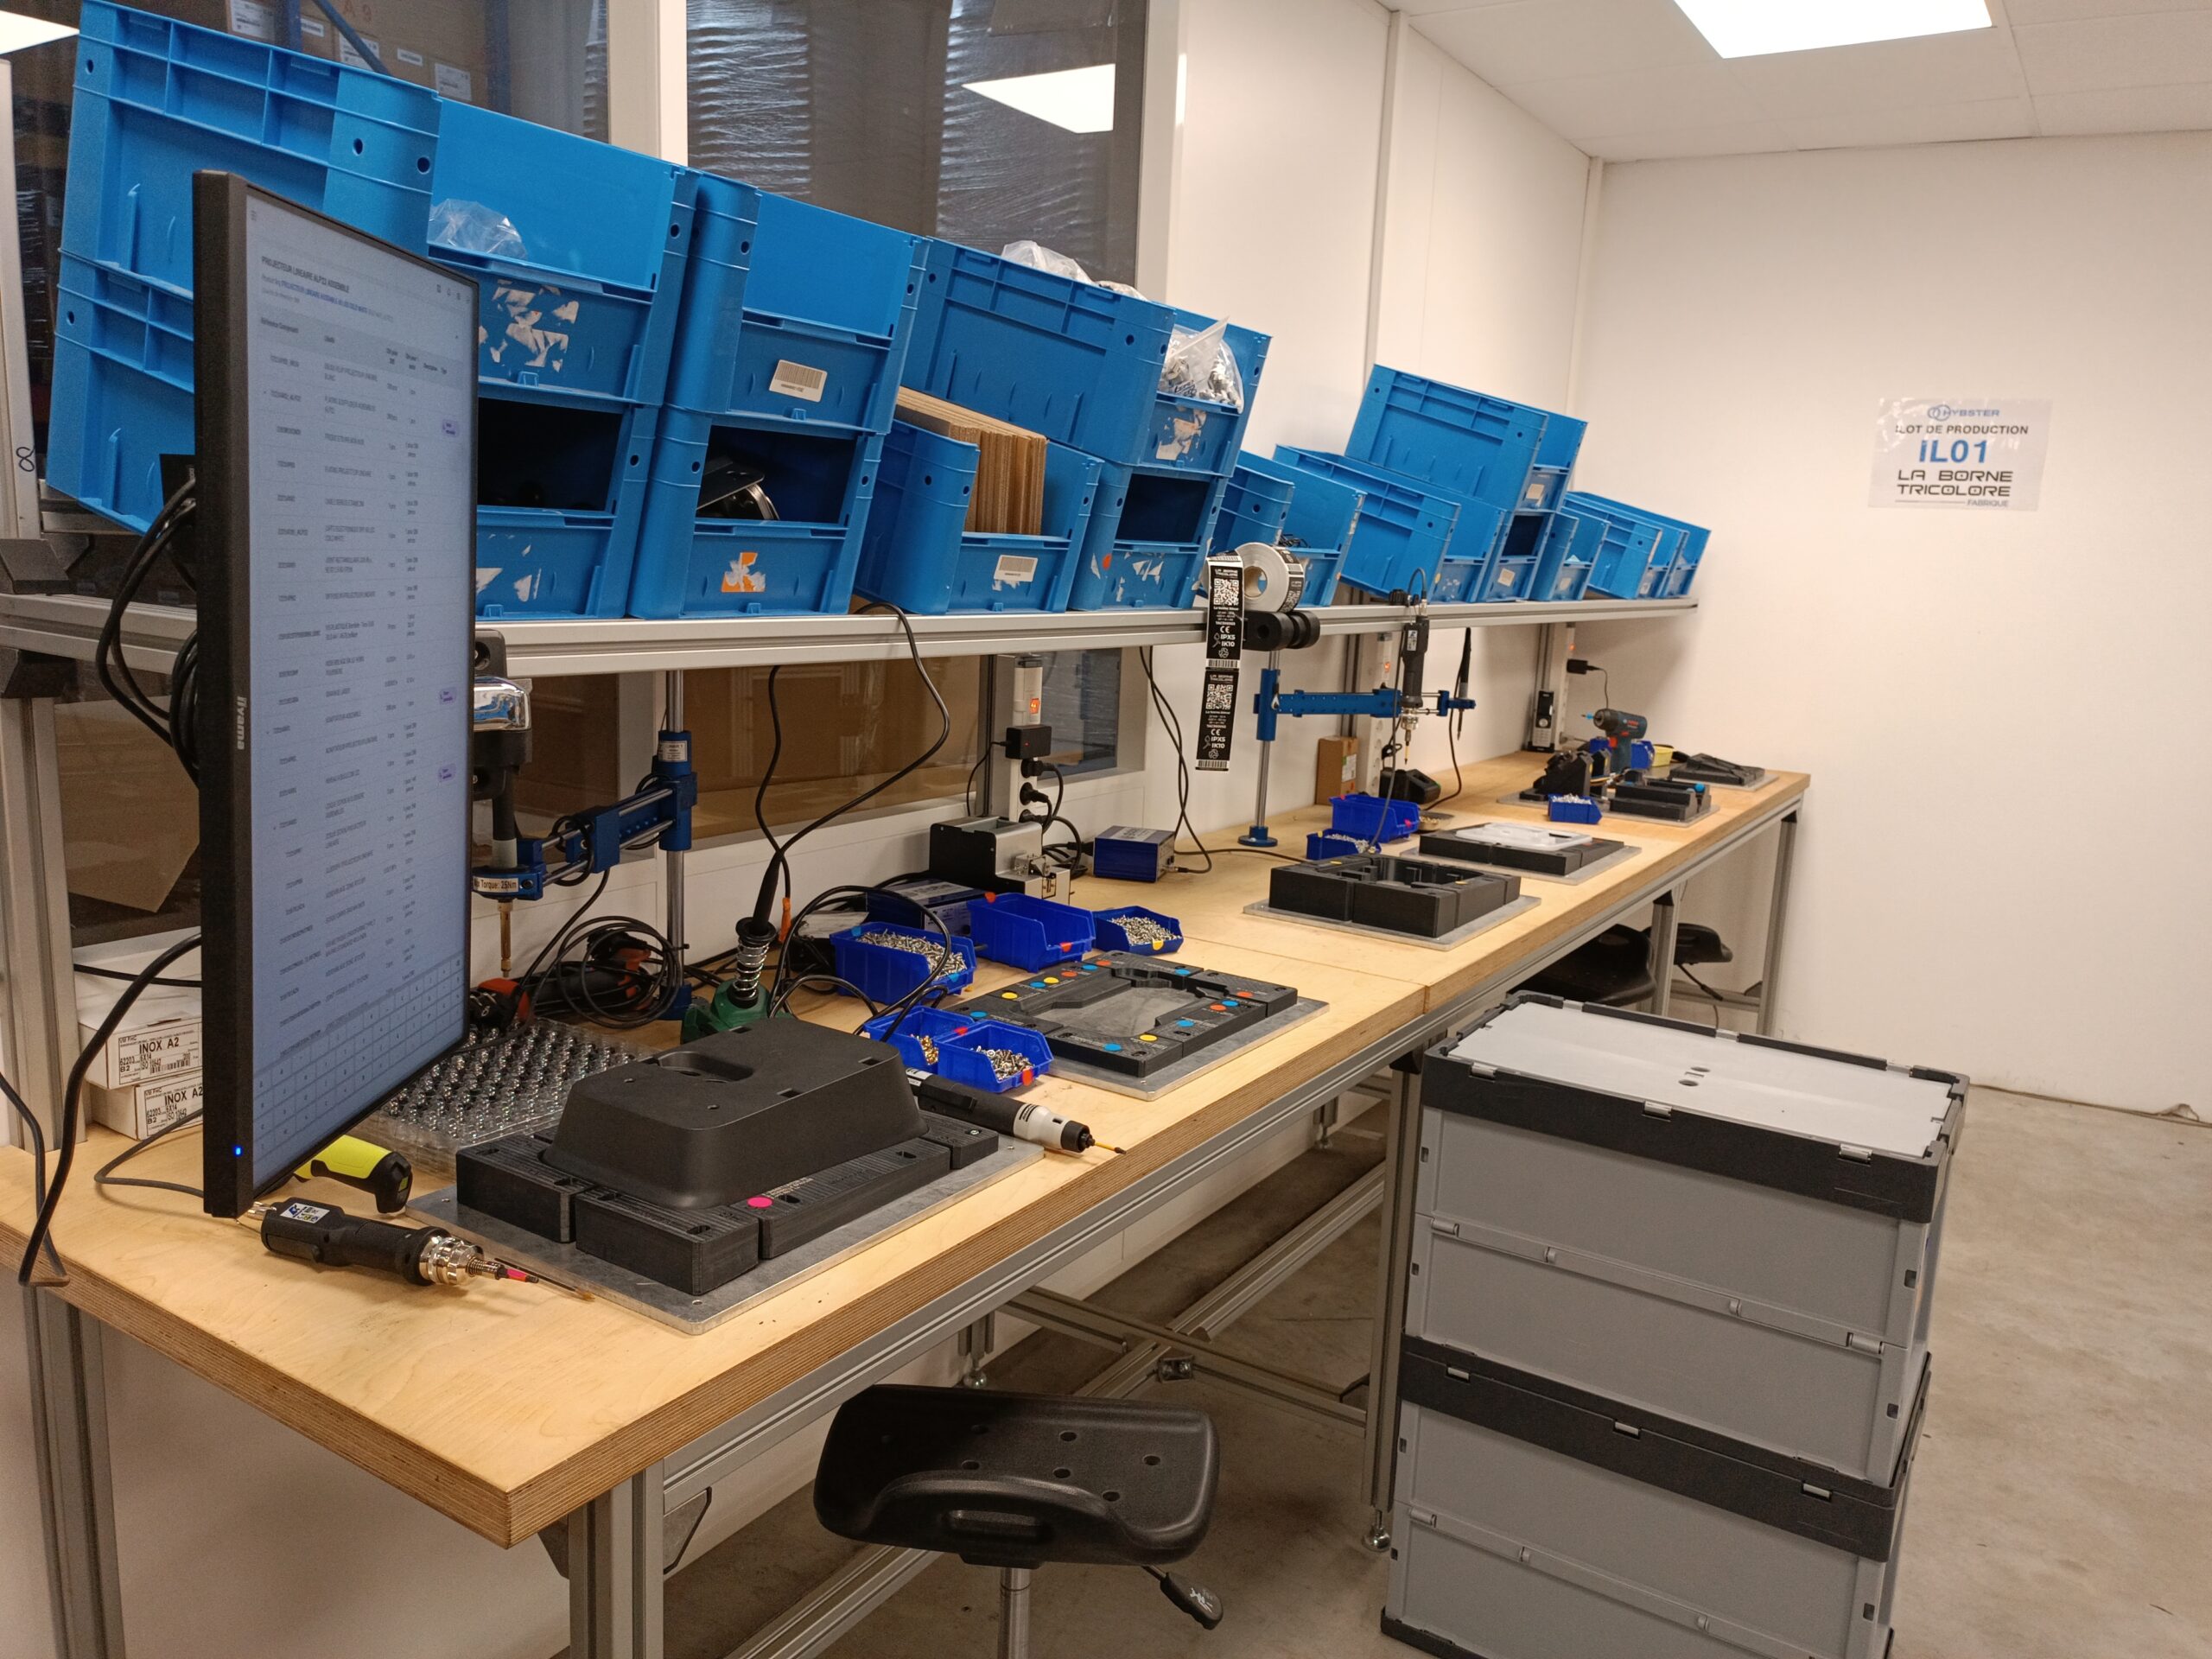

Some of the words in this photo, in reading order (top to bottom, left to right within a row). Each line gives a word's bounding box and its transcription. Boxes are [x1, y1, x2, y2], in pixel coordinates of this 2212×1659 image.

[1926, 425, 1942, 434] DE
[1946, 425, 2029, 435] PRODUCTION
[1898, 470, 1926, 481] LA
[1939, 470, 2013, 482] BORNE
[1897, 484, 2011, 497] TRICOLORE
[139, 1040, 162, 1054] INOX
[168, 1037, 179, 1049] A2
[165, 1090, 187, 1105] INOX
[192, 1086, 203, 1098] A2
